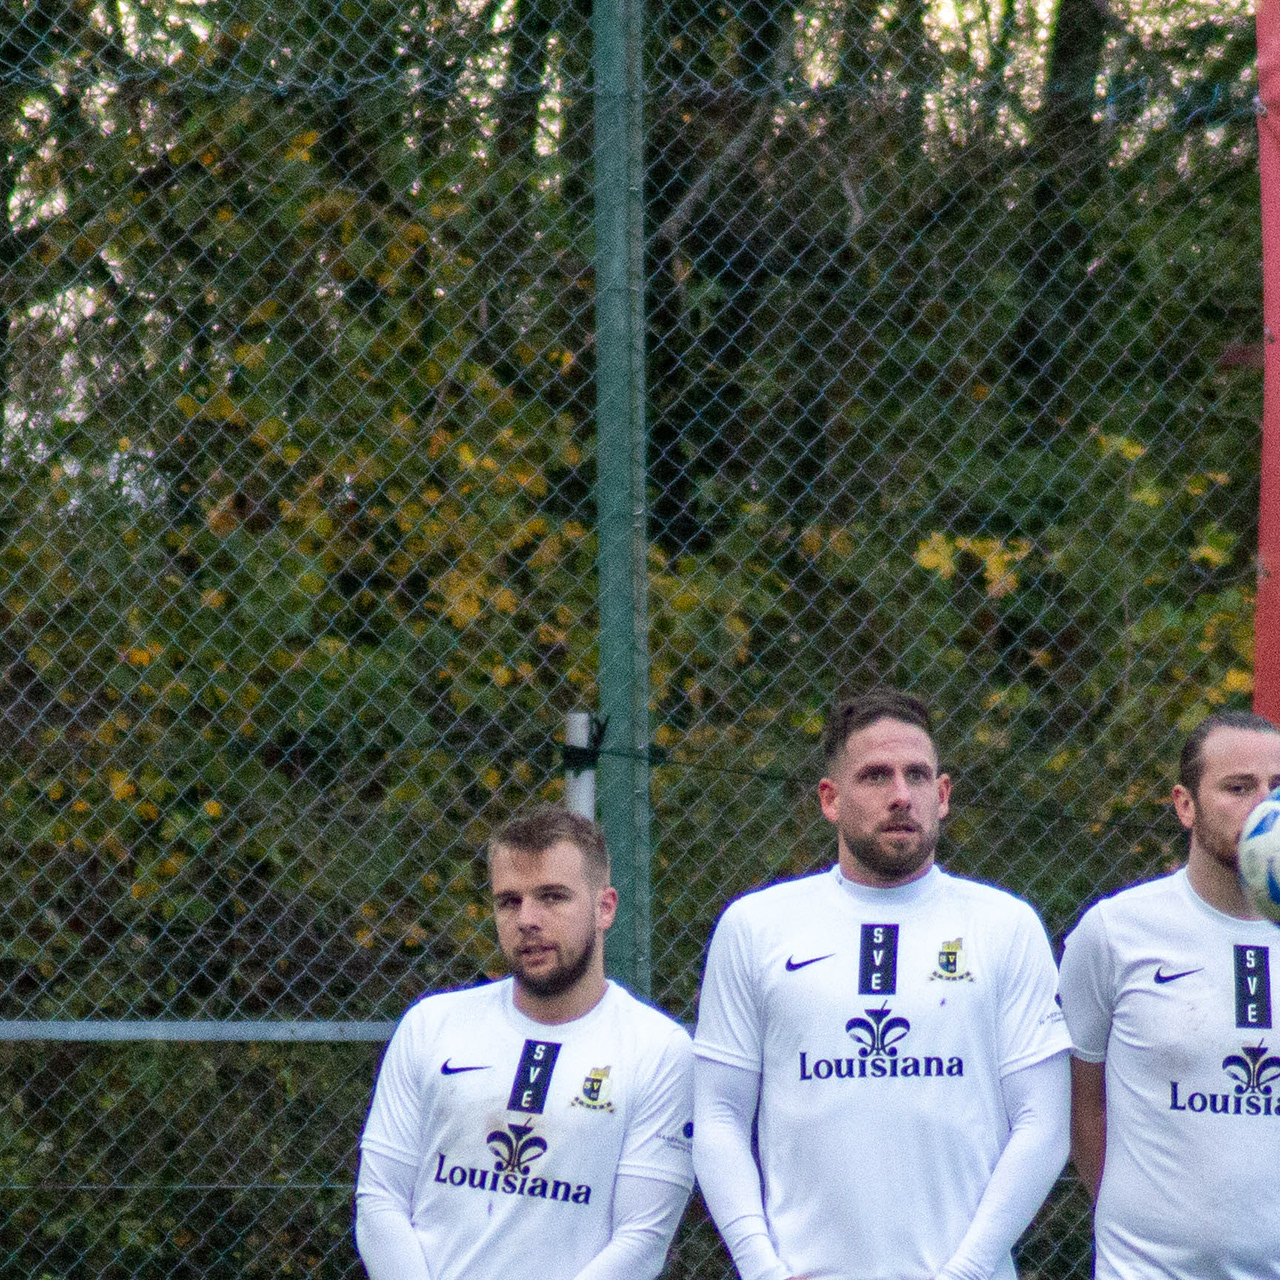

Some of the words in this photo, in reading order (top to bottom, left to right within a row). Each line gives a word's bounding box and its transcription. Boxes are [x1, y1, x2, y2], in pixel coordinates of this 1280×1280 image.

[871, 927, 884, 990] SVE
[1246, 950, 1258, 1022] SVE
[521, 1044, 546, 1108] SVE
[799, 1052, 964, 1081] Louisiana
[434, 1153, 593, 1205] Louisiana
